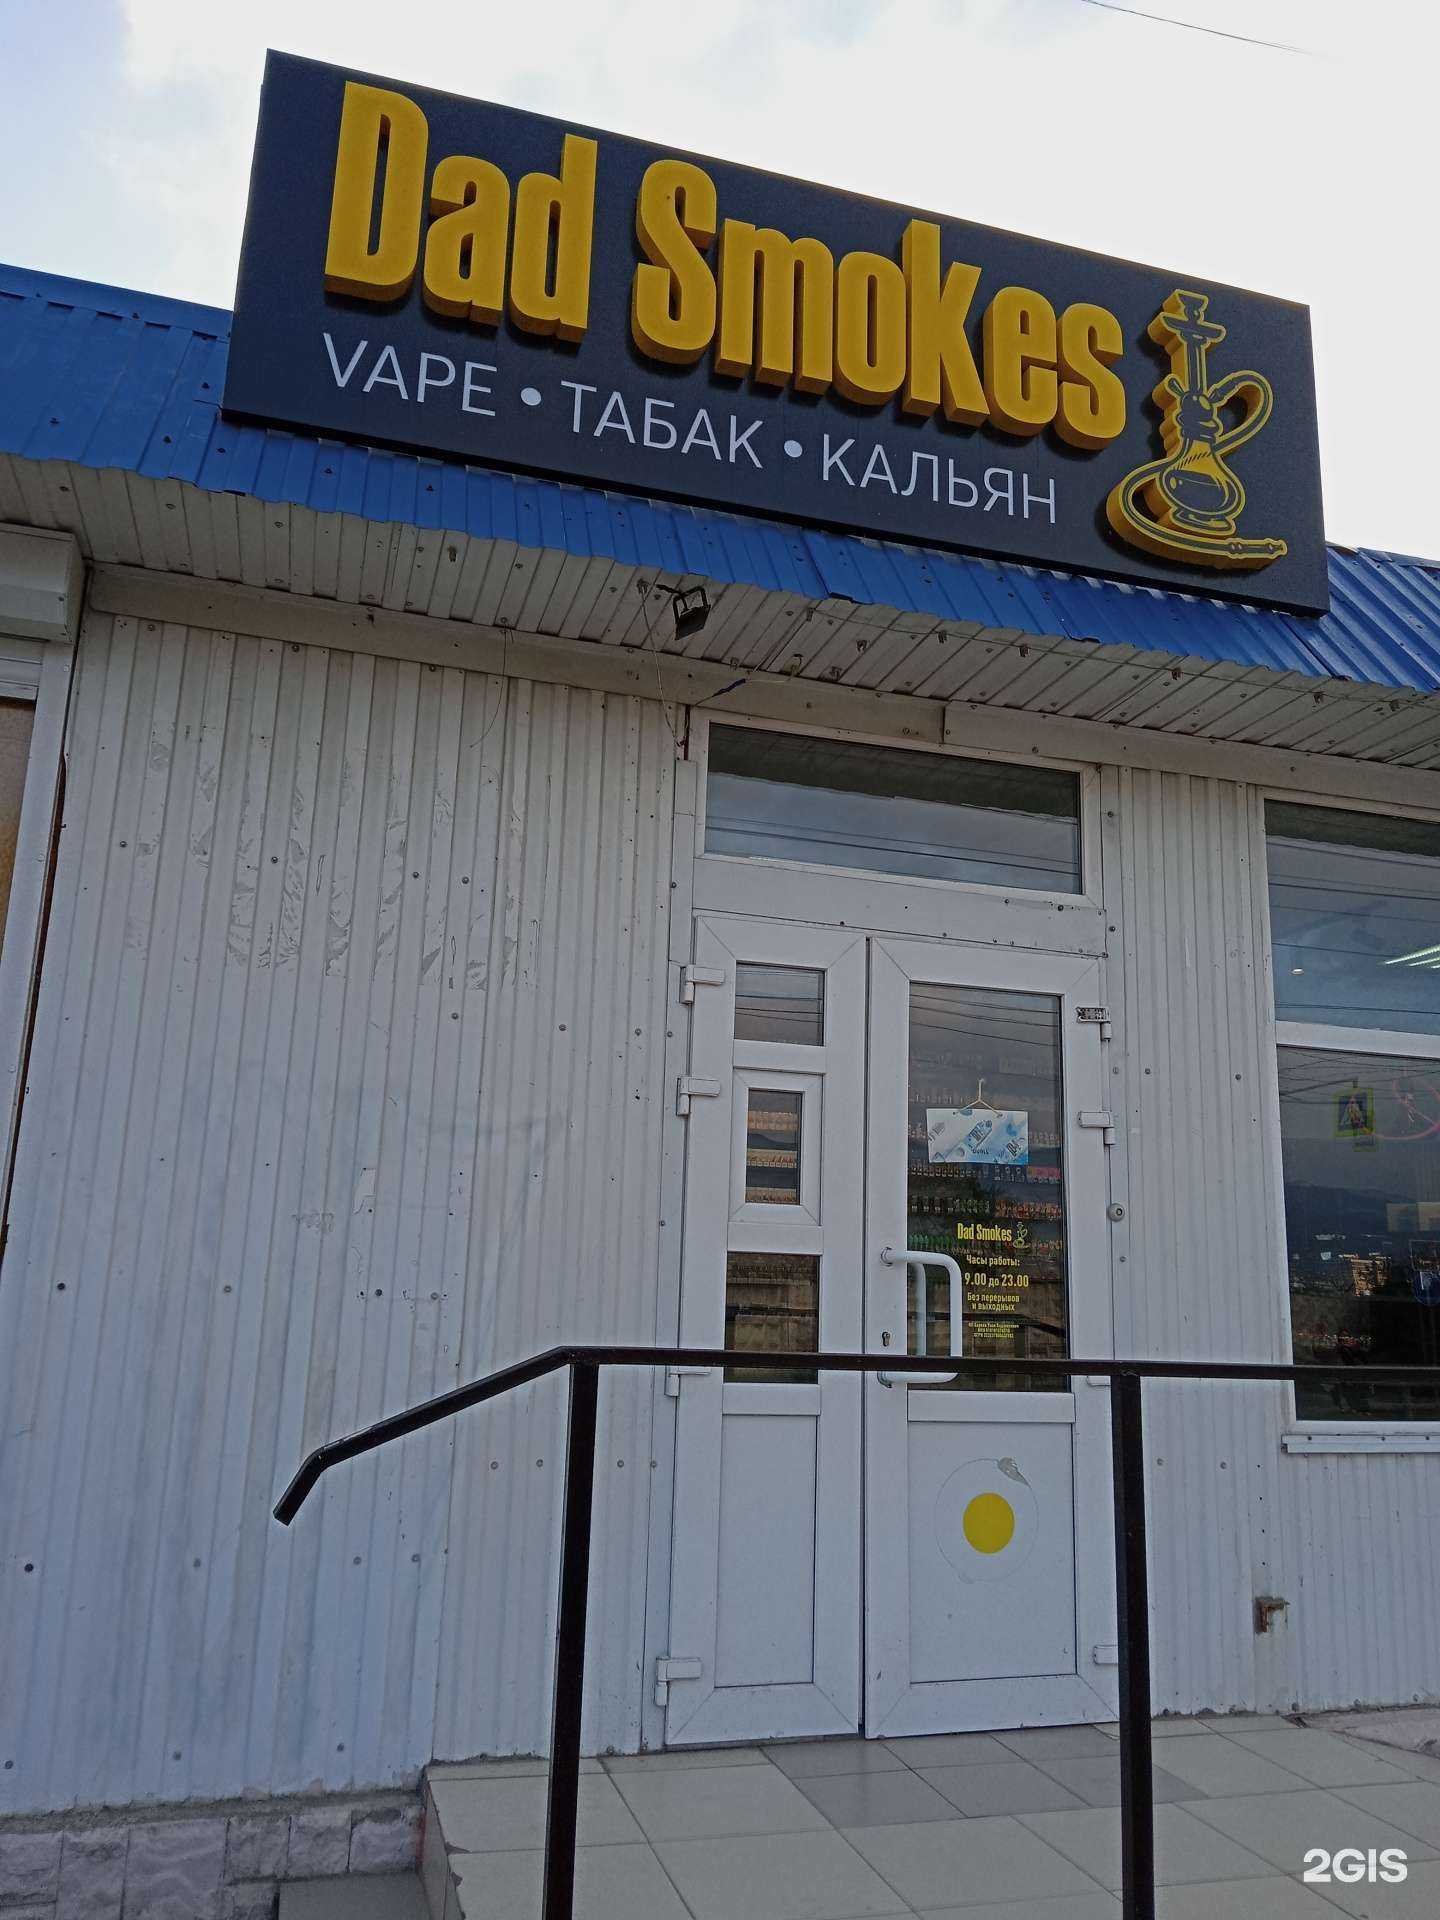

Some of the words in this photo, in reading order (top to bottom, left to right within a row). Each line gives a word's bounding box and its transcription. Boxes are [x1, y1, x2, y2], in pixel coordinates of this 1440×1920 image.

[324, 81, 598, 340] Dad
[631, 159, 1127, 450] Smokes
[322, 333, 498, 417] VAPE
[560, 380, 764, 469] ТАБАК
[822, 433, 1056, 523] КАЛЬЯН
[957, 1222, 975, 1240] Dad
[976, 1223, 1012, 1242] Smokes
[966, 1254, 988, 1265] Часы
[989, 1256, 1021, 1267] работы:
[964, 1272, 987, 1286] 9.00
[988, 1277, 1000, 1288] до
[1001, 1273, 1029, 1288] 23.00
[967, 1292, 980, 1301] Без
[981, 1293, 1020, 1303] перерывов
[978, 1302, 1015, 1312] выходных
